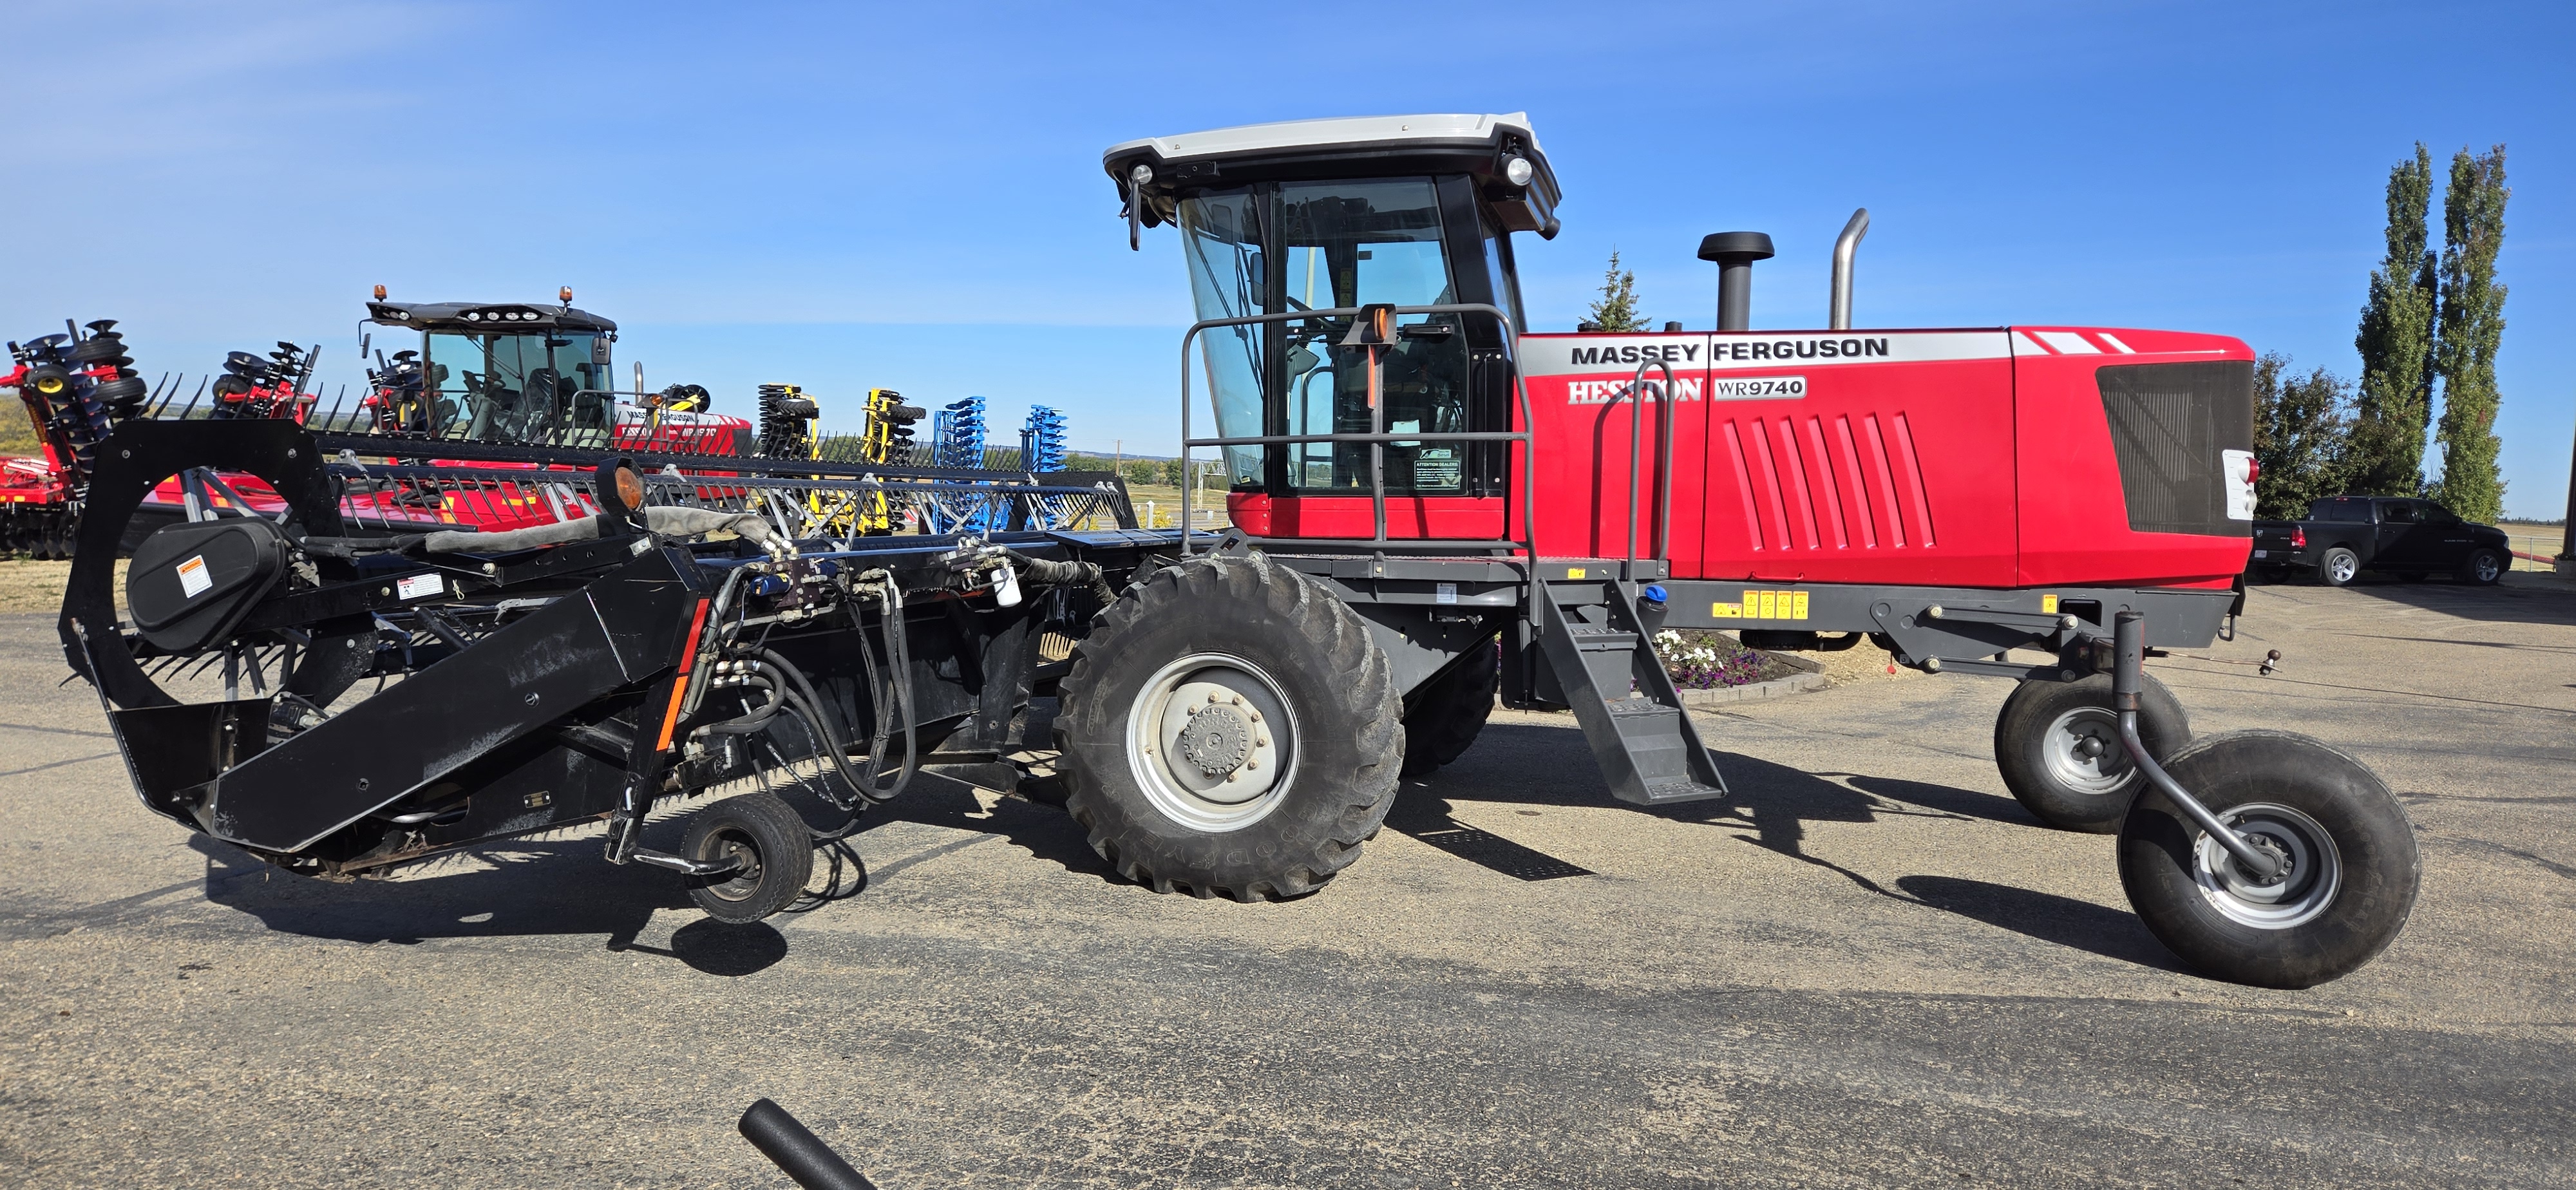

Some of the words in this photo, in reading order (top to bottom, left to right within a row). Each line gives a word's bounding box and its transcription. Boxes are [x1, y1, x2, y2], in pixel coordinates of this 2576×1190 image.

[1571, 343, 1701, 365] MASSEY
[1714, 338, 1889, 361] FERGUSON
[1568, 377, 1703, 405] HESSTON
[1718, 381, 1803, 395] WR9740
